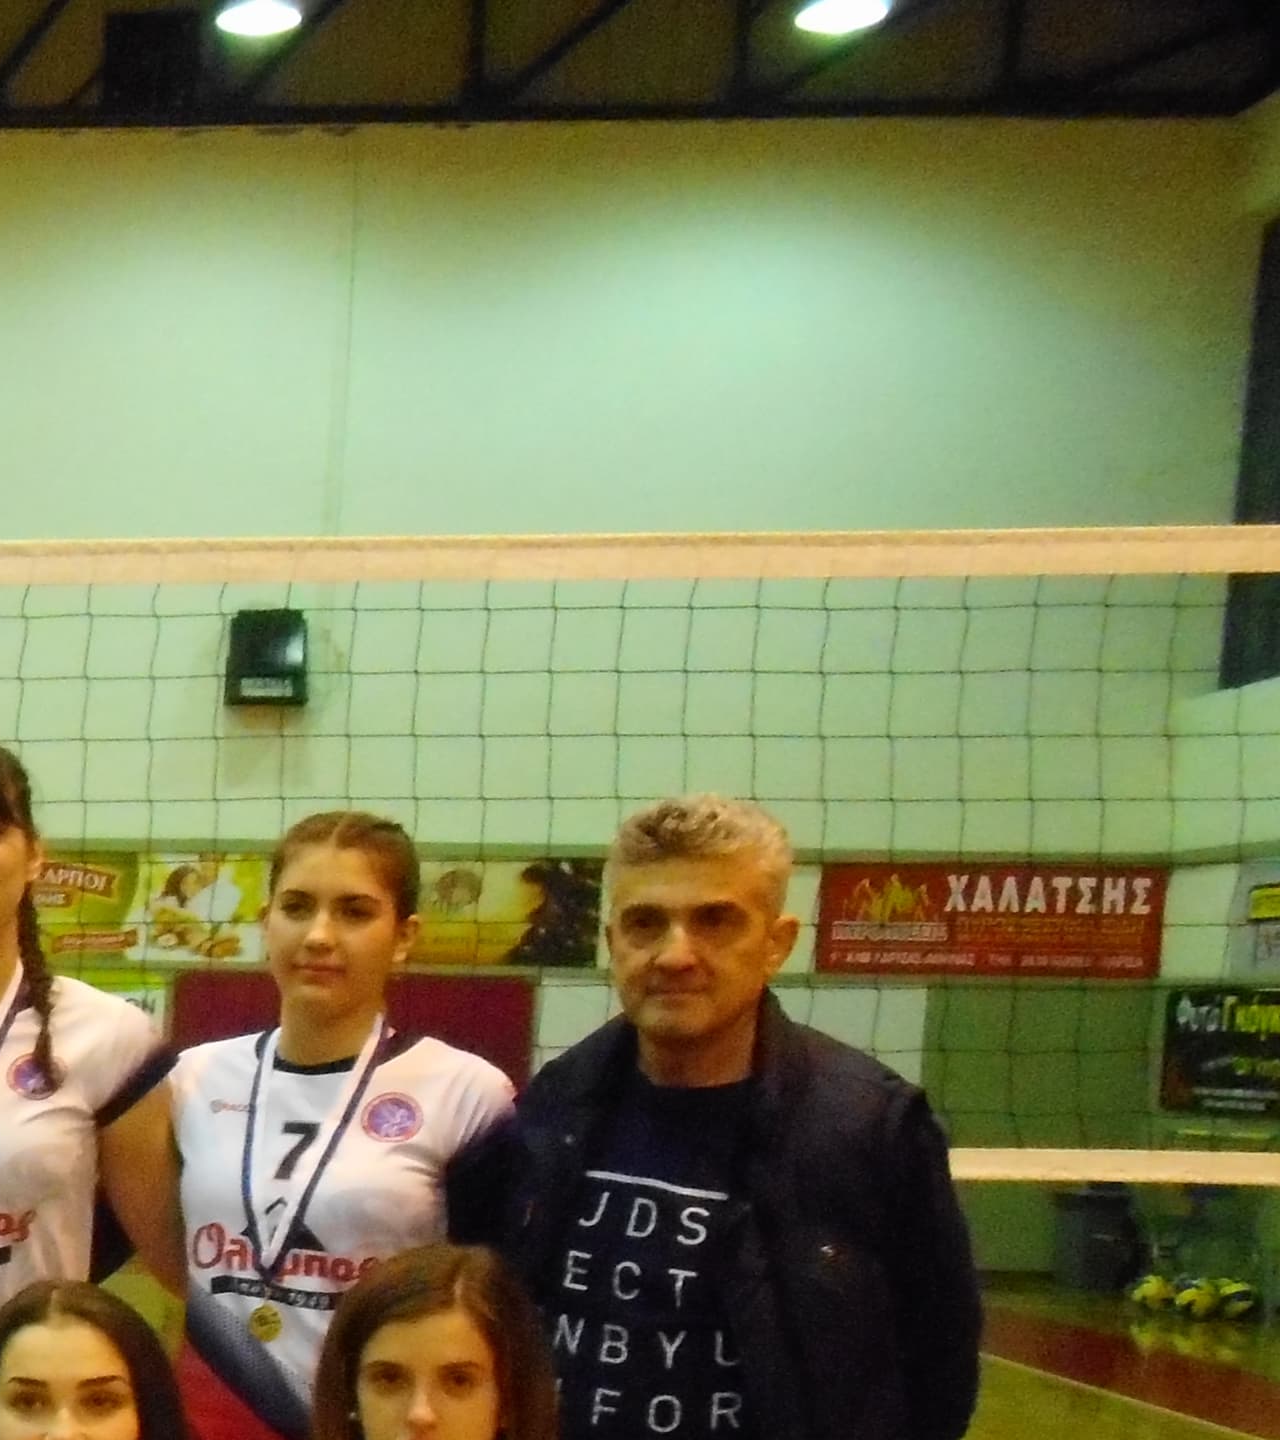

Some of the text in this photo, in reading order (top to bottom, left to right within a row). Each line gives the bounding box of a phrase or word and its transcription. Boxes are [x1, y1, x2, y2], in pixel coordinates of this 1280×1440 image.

[943, 874, 1153, 915] ΧΑΛΑΤΣΗΣ
[274, 1122, 321, 1180] 7
[578, 1191, 711, 1246] JDS
[562, 1249, 699, 1308] ECT
[591, 1387, 742, 1433] FOR
